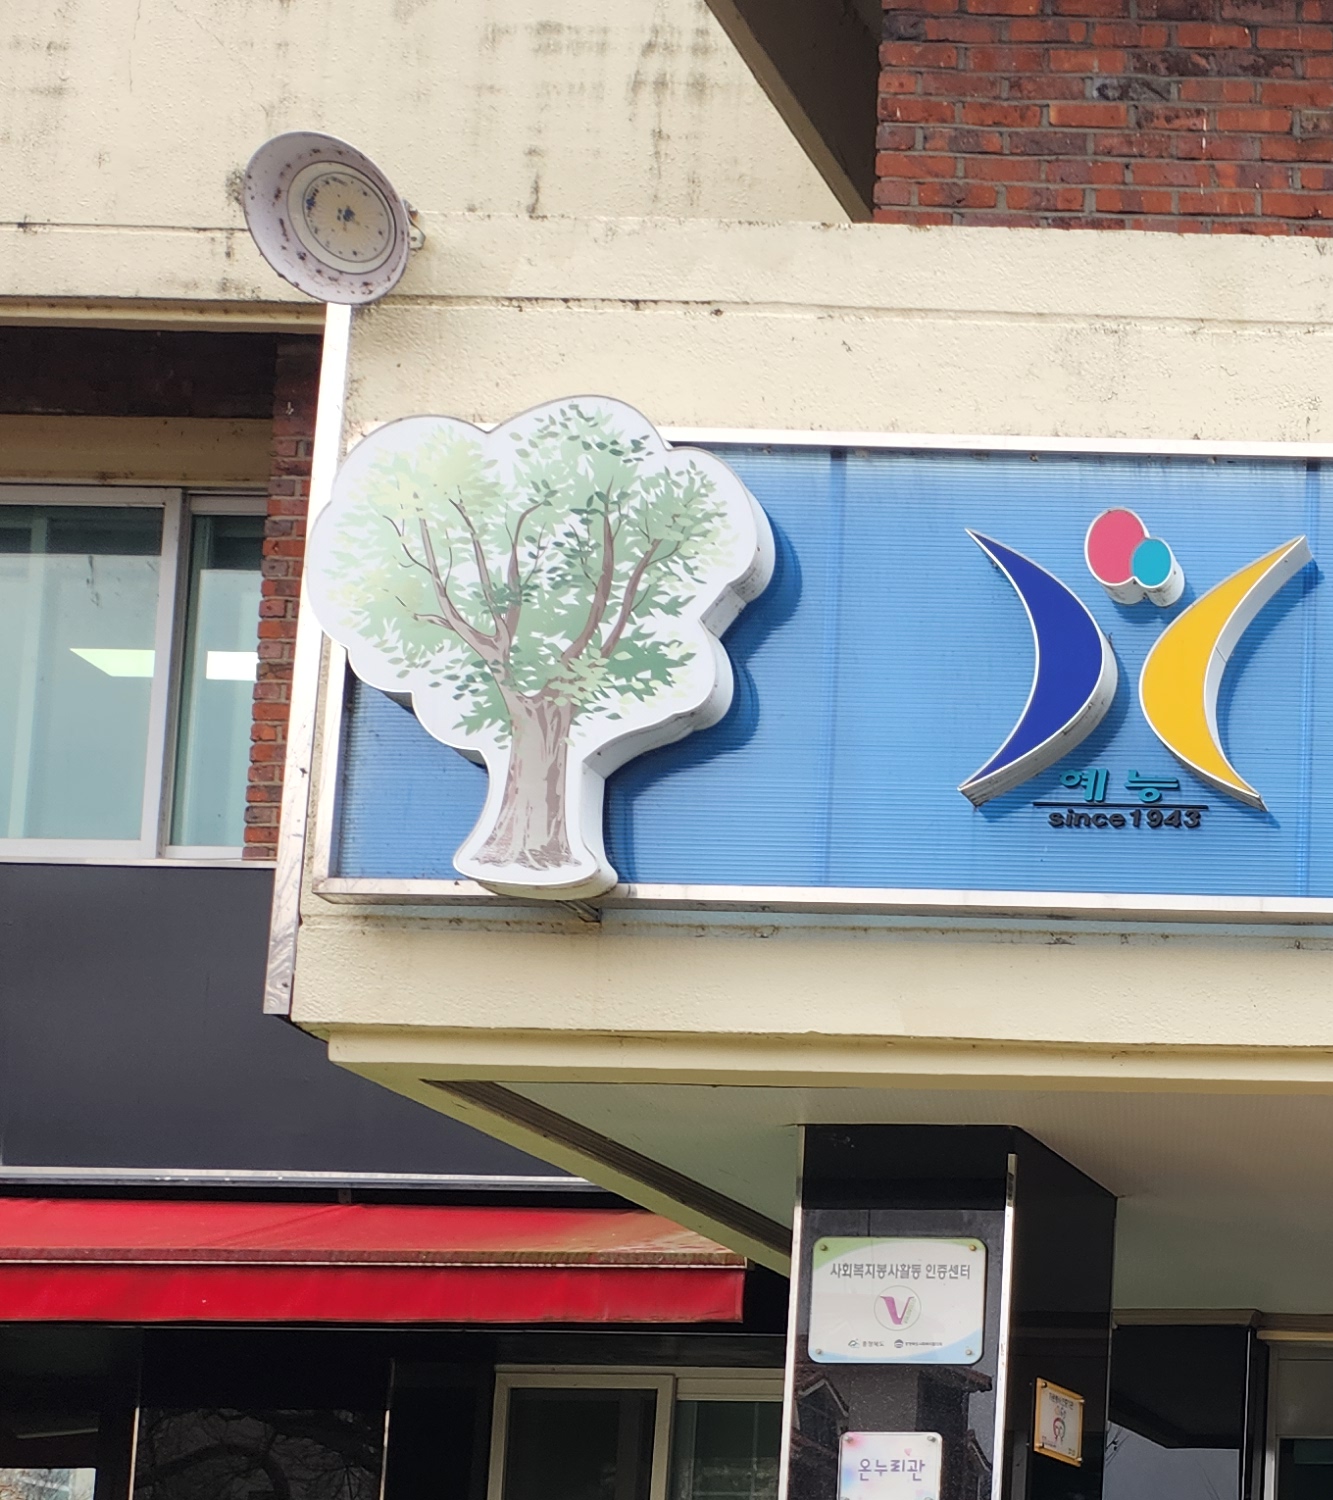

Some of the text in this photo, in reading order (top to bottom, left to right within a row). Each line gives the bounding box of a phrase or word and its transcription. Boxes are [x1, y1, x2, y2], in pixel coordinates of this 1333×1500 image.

[830, 1263, 970, 1280] 사회복지봉사활동 인증센터
[858, 1459, 925, 1481] 온누리관
